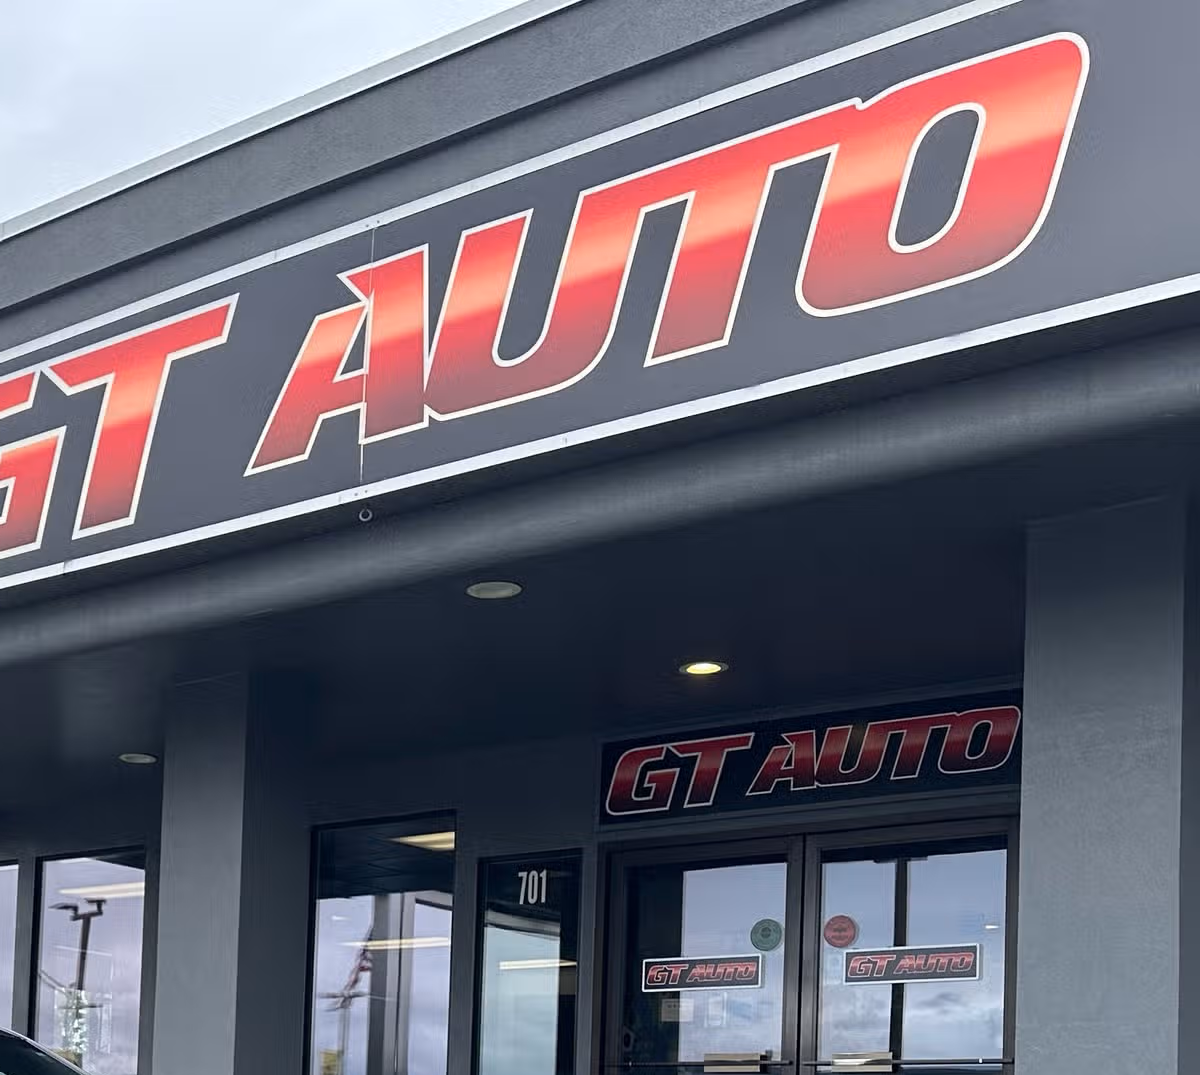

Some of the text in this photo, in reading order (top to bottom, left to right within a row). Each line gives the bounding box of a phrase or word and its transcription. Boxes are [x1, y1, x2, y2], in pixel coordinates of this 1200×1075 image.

[243, 31, 1091, 476] AUTO
[605, 704, 1021, 816] GT AUTO
[518, 868, 547, 905] 701
[646, 962, 758, 985] GT AUTO
[847, 952, 975, 978] GT AUTO
